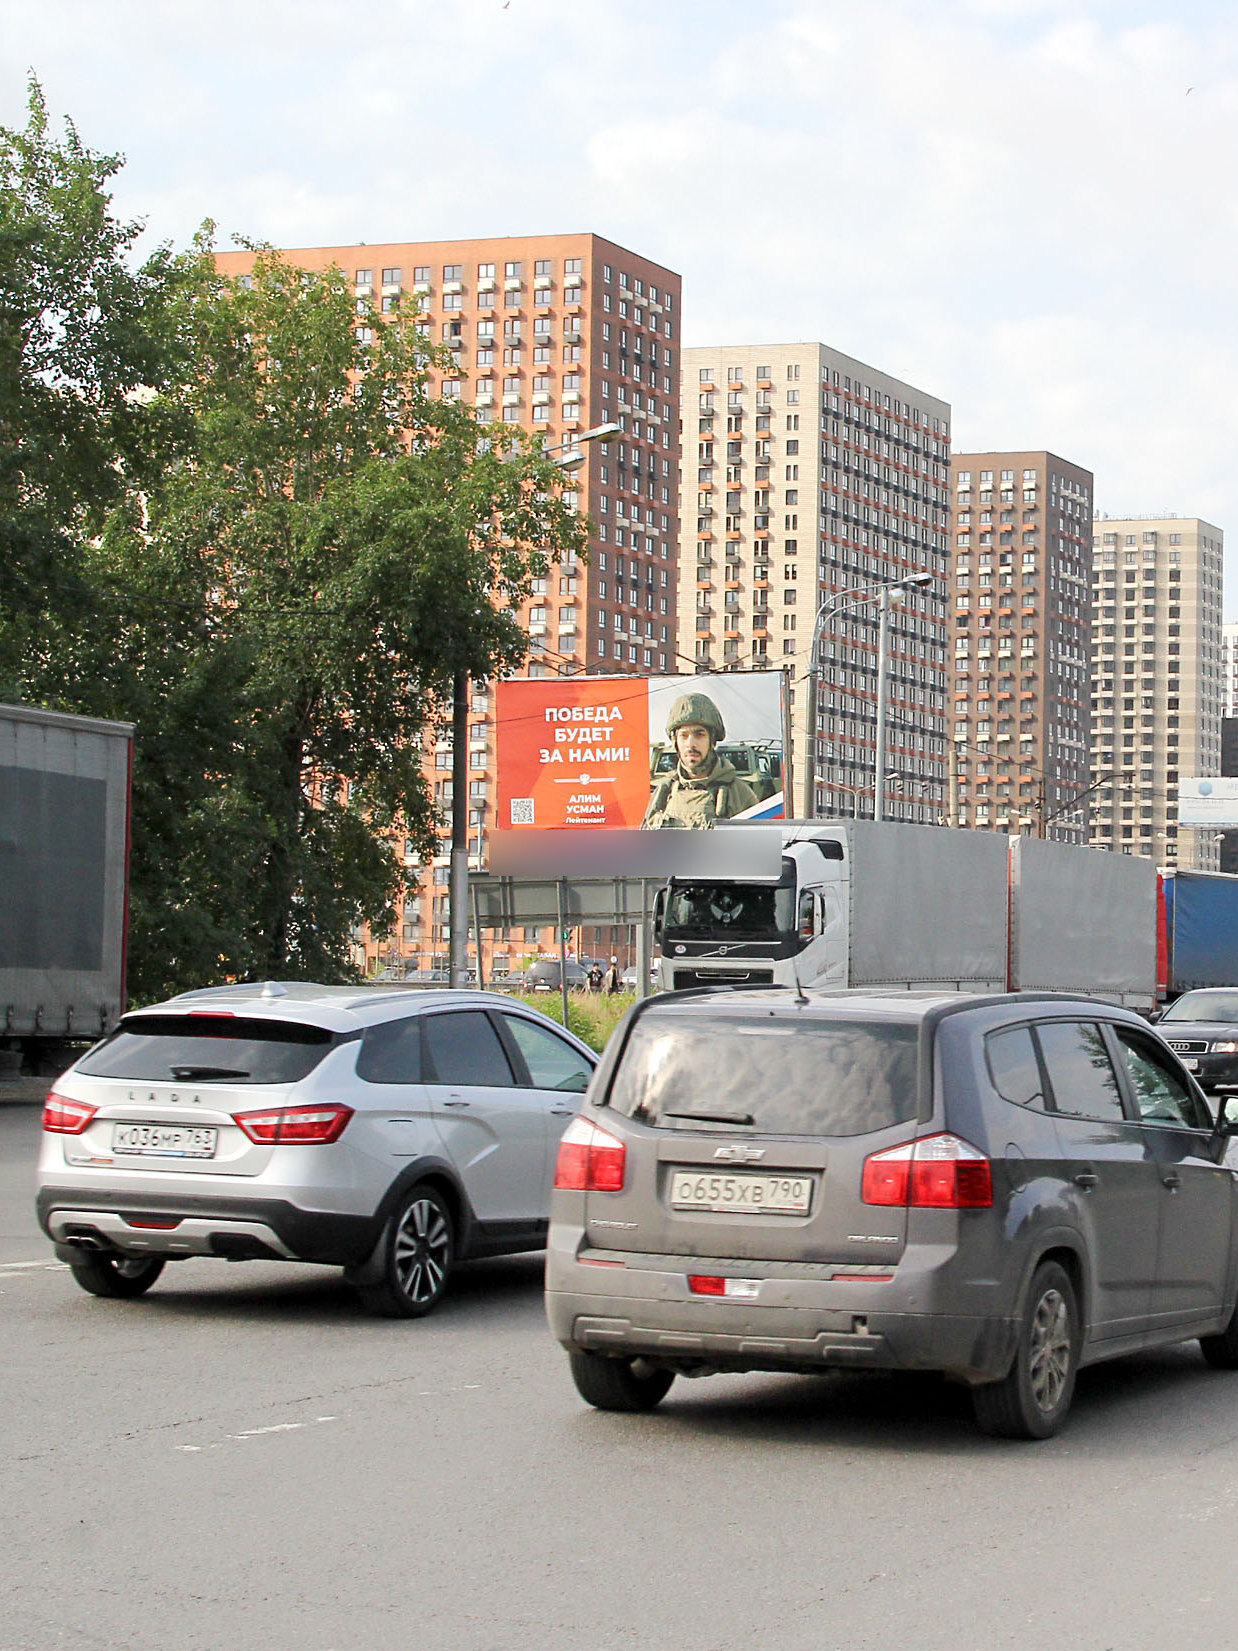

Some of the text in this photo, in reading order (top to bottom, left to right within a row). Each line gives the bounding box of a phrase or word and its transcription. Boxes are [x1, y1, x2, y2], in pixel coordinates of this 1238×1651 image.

[545, 706, 623, 723] ПОБЕДА
[554, 727, 614, 744] БУДЕТ
[539, 747, 630, 763] ЗА НАМИ!
[569, 794, 602, 803] АЛИМ
[566, 805, 605, 814] УСМАН
[565, 816, 606, 824] Лейтенант
[128, 1091, 201, 1103] LADA
[117, 1127, 182, 1147] К036МР
[679, 1177, 803, 1203] О655ХВ 790
